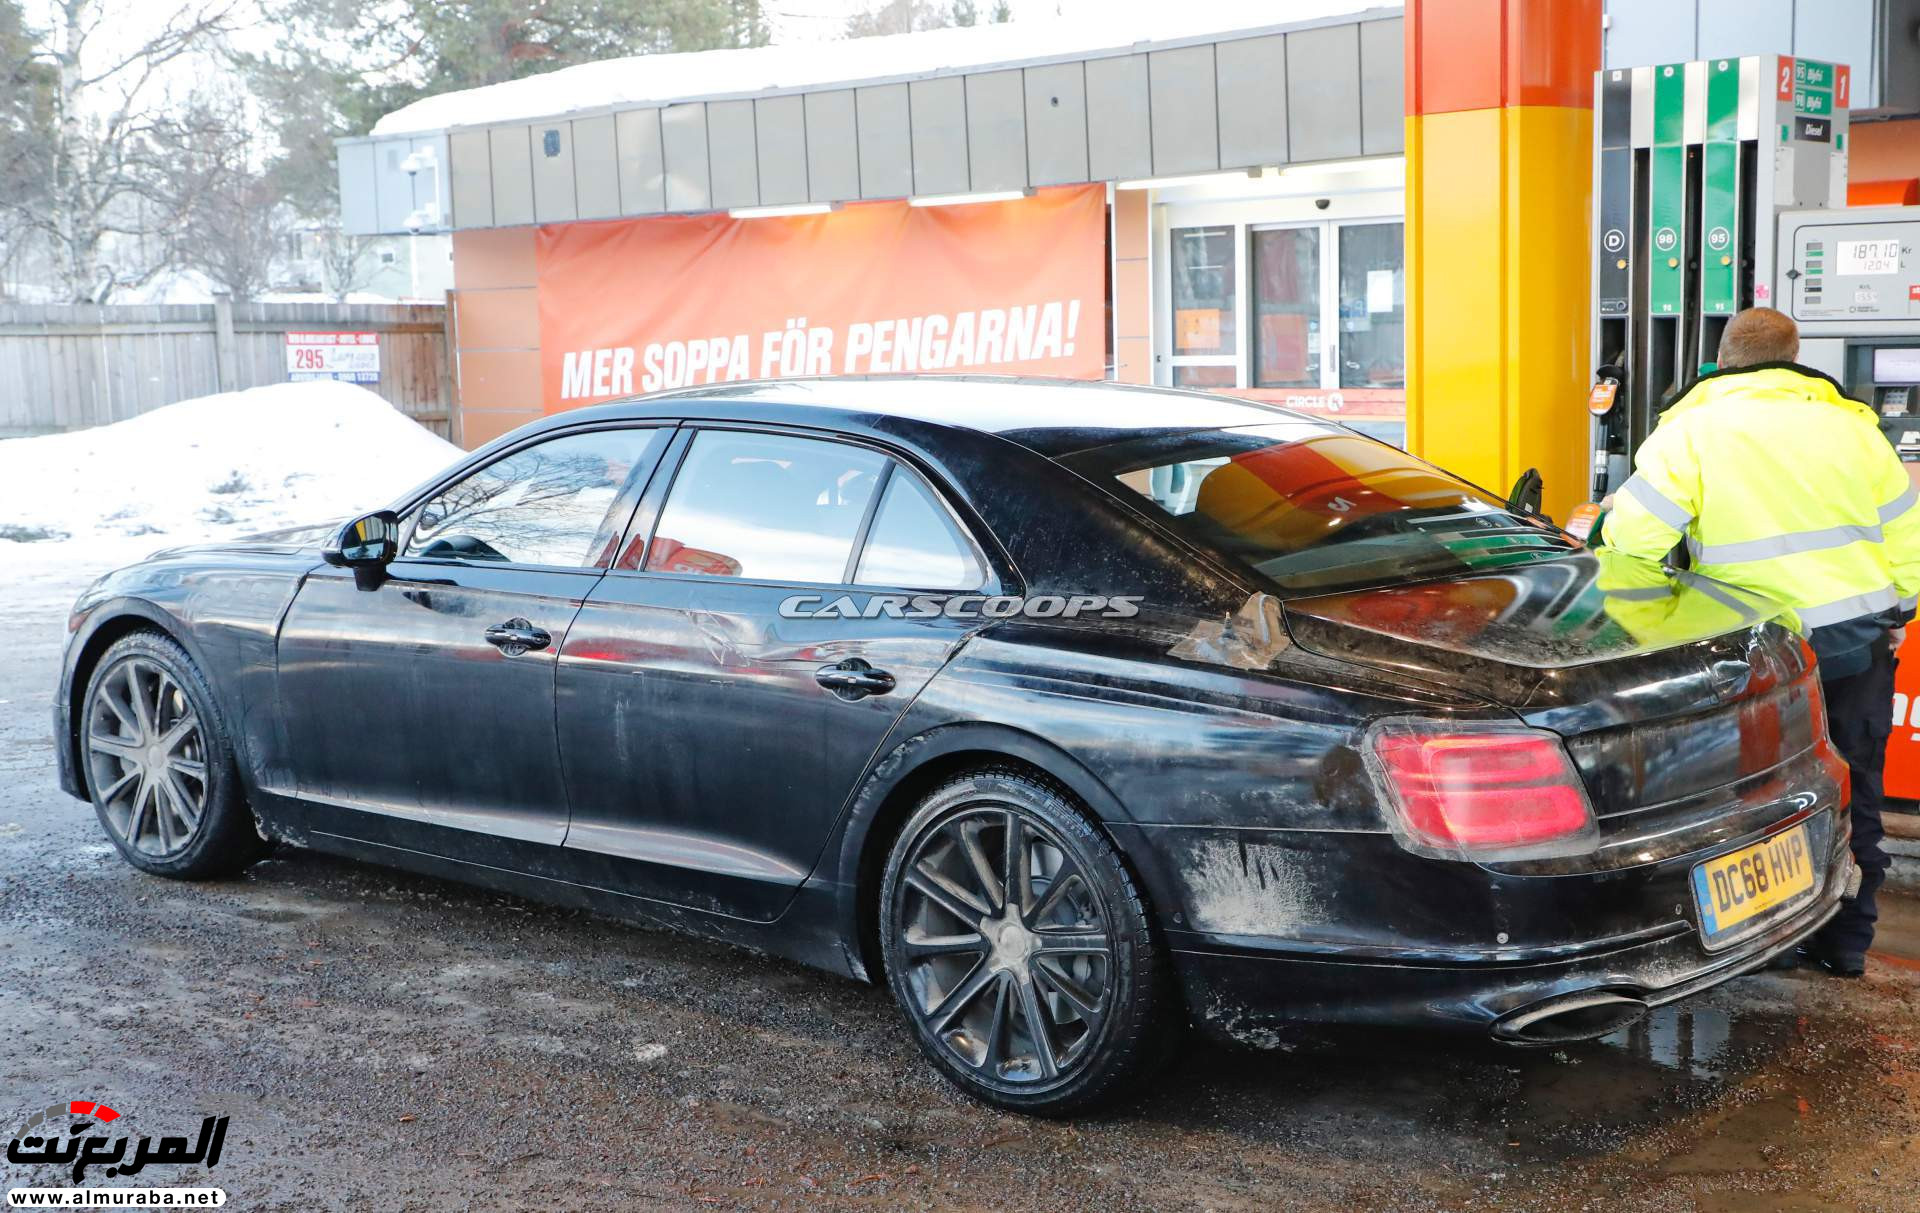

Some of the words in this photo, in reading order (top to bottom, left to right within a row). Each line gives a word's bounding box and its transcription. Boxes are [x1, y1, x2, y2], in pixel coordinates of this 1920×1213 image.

[1780, 66, 1791, 93] 2
[1839, 74, 1847, 100] 1
[1805, 123, 1823, 137] Diesel
[1608, 235, 1620, 247] D
[1658, 234, 1674, 244] 98
[1711, 233, 1726, 244] 95
[561, 347, 635, 399] MER
[641, 335, 749, 393] SOPPA
[760, 317, 834, 379] FÖR
[844, 300, 1081, 374] PENGARNA!
[295, 348, 324, 369] 295
[1285, 395, 1326, 408] CIRCLE
[1712, 852, 1769, 912] DC68
[1768, 834, 1803, 887] HVP
